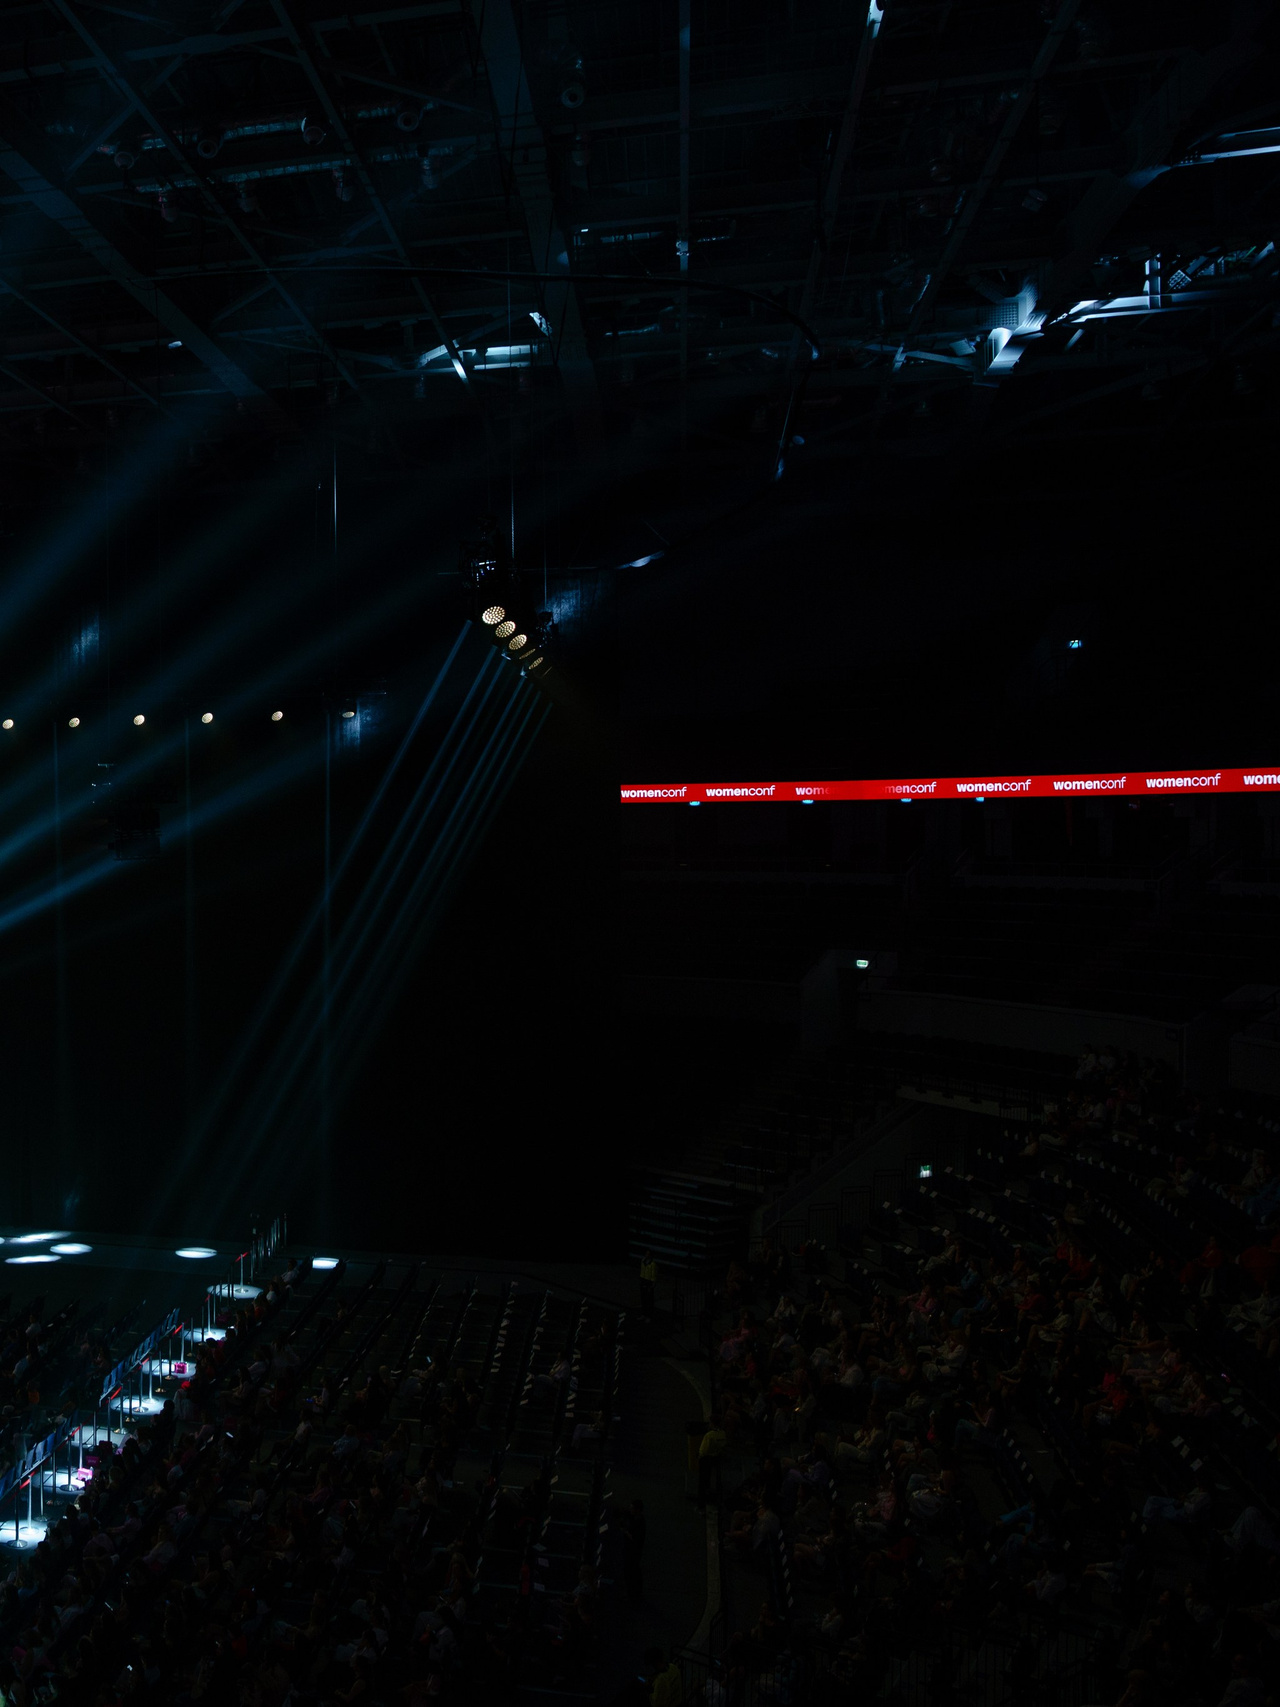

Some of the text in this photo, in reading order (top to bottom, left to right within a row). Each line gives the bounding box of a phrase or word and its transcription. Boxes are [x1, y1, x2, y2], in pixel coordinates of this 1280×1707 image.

[621, 787, 687, 799] womenconf
[706, 785, 775, 797] womenconf
[957, 779, 1031, 793] womenconf
[1053, 777, 1126, 791] womenconf
[1146, 773, 1221, 788] womenconf
